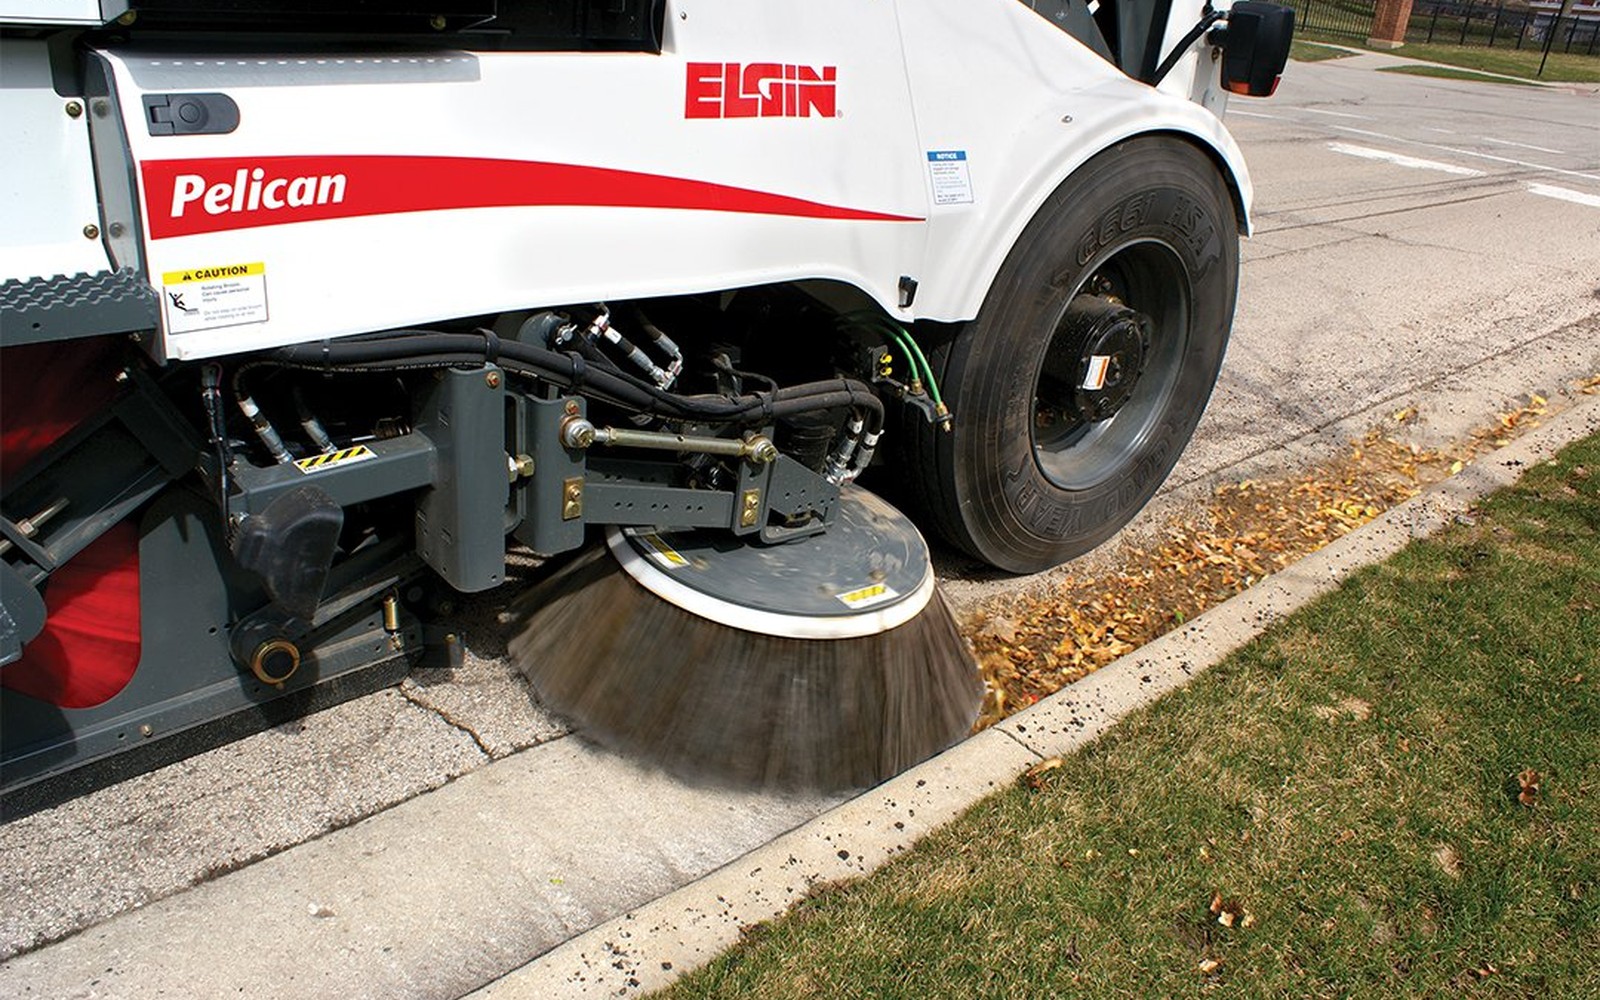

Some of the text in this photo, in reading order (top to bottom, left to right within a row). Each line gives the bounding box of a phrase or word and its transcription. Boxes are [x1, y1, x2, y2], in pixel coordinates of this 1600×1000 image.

[685, 62, 837, 119] ELGIN
[170, 167, 347, 218] Pelican
[195, 266, 248, 279] CAUTION
